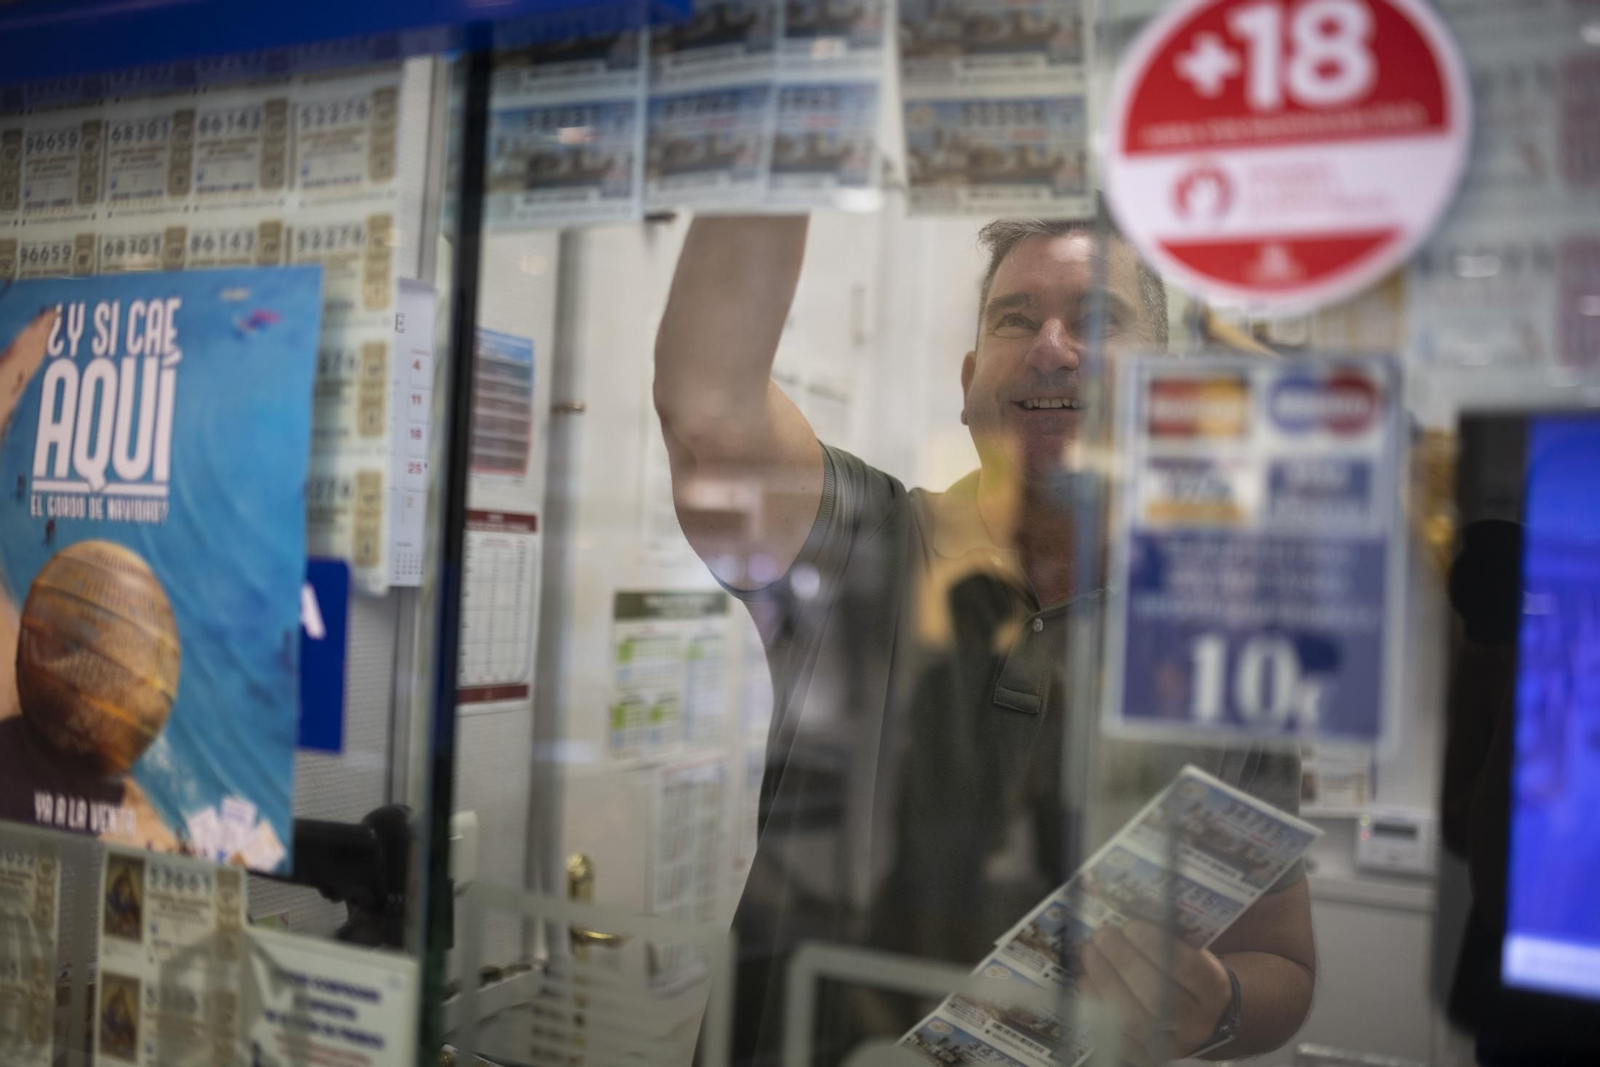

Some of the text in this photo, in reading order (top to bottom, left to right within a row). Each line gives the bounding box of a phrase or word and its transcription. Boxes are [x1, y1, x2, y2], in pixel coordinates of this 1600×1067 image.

[1175, 0, 1378, 110] +18
[111, 119, 169, 141] 68301
[26, 131, 78, 155] 96659
[20, 244, 72, 266] 96659
[47, 298, 181, 357] ¿Y SI CAE
[411, 394, 422, 406] 11
[33, 345, 181, 484] AQUÍ
[410, 428, 421, 441] 18
[31, 494, 42, 517] EL
[48, 496, 84, 518] GORDO
[89, 497, 103, 519] DE
[34, 790, 53, 822] YA
[55, 795, 66, 826] A
[68, 797, 87, 829] LA
